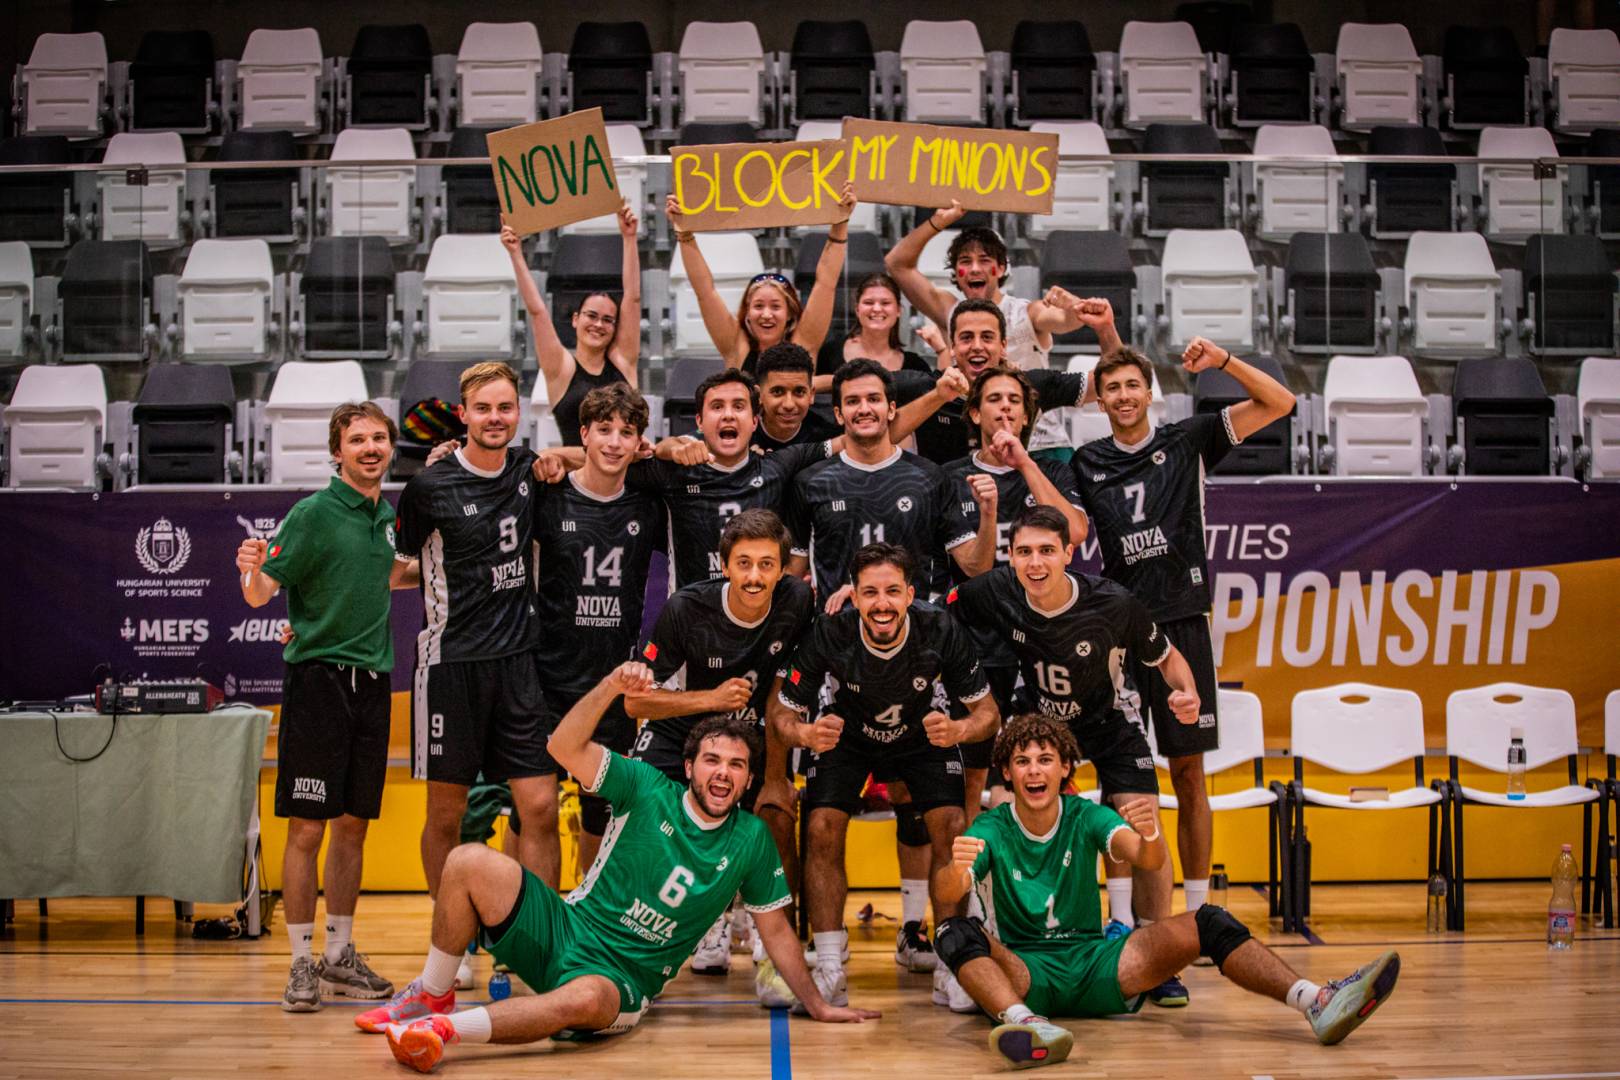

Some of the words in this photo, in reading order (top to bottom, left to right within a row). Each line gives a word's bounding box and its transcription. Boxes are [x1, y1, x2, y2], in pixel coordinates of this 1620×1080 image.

[497, 134, 614, 214] NOVA
[849, 134, 899, 183] MY
[909, 135, 1052, 196] MINIONS
[674, 147, 845, 215] BLOCK
[1123, 481, 1146, 523] 7
[1121, 525, 1167, 556] NOVA
[1124, 545, 1169, 566] UNVERSITY
[582, 545, 624, 587] 14
[117, 579, 163, 588] HUNGARIAN
[165, 579, 211, 588] UNIVERSITY
[125, 589, 136, 597] OF
[138, 589, 169, 597] SPORTS
[171, 589, 202, 597] SCIENCE
[576, 595, 622, 616] NOVA
[1213, 569, 1560, 668] PIONSHIP
[139, 618, 209, 642] MEFS
[575, 616, 621, 627] UNIVERSITY
[1034, 660, 1072, 695] 16
[431, 713, 444, 738] 9
[875, 704, 903, 727] 4
[292, 791, 327, 803] UNIVERSITY
[293, 777, 327, 796] NOVA
[658, 865, 695, 909] 6
[625, 897, 678, 938] NOVA
[1044, 893, 1060, 929] 1
[619, 914, 669, 946] UNIVERSITY
